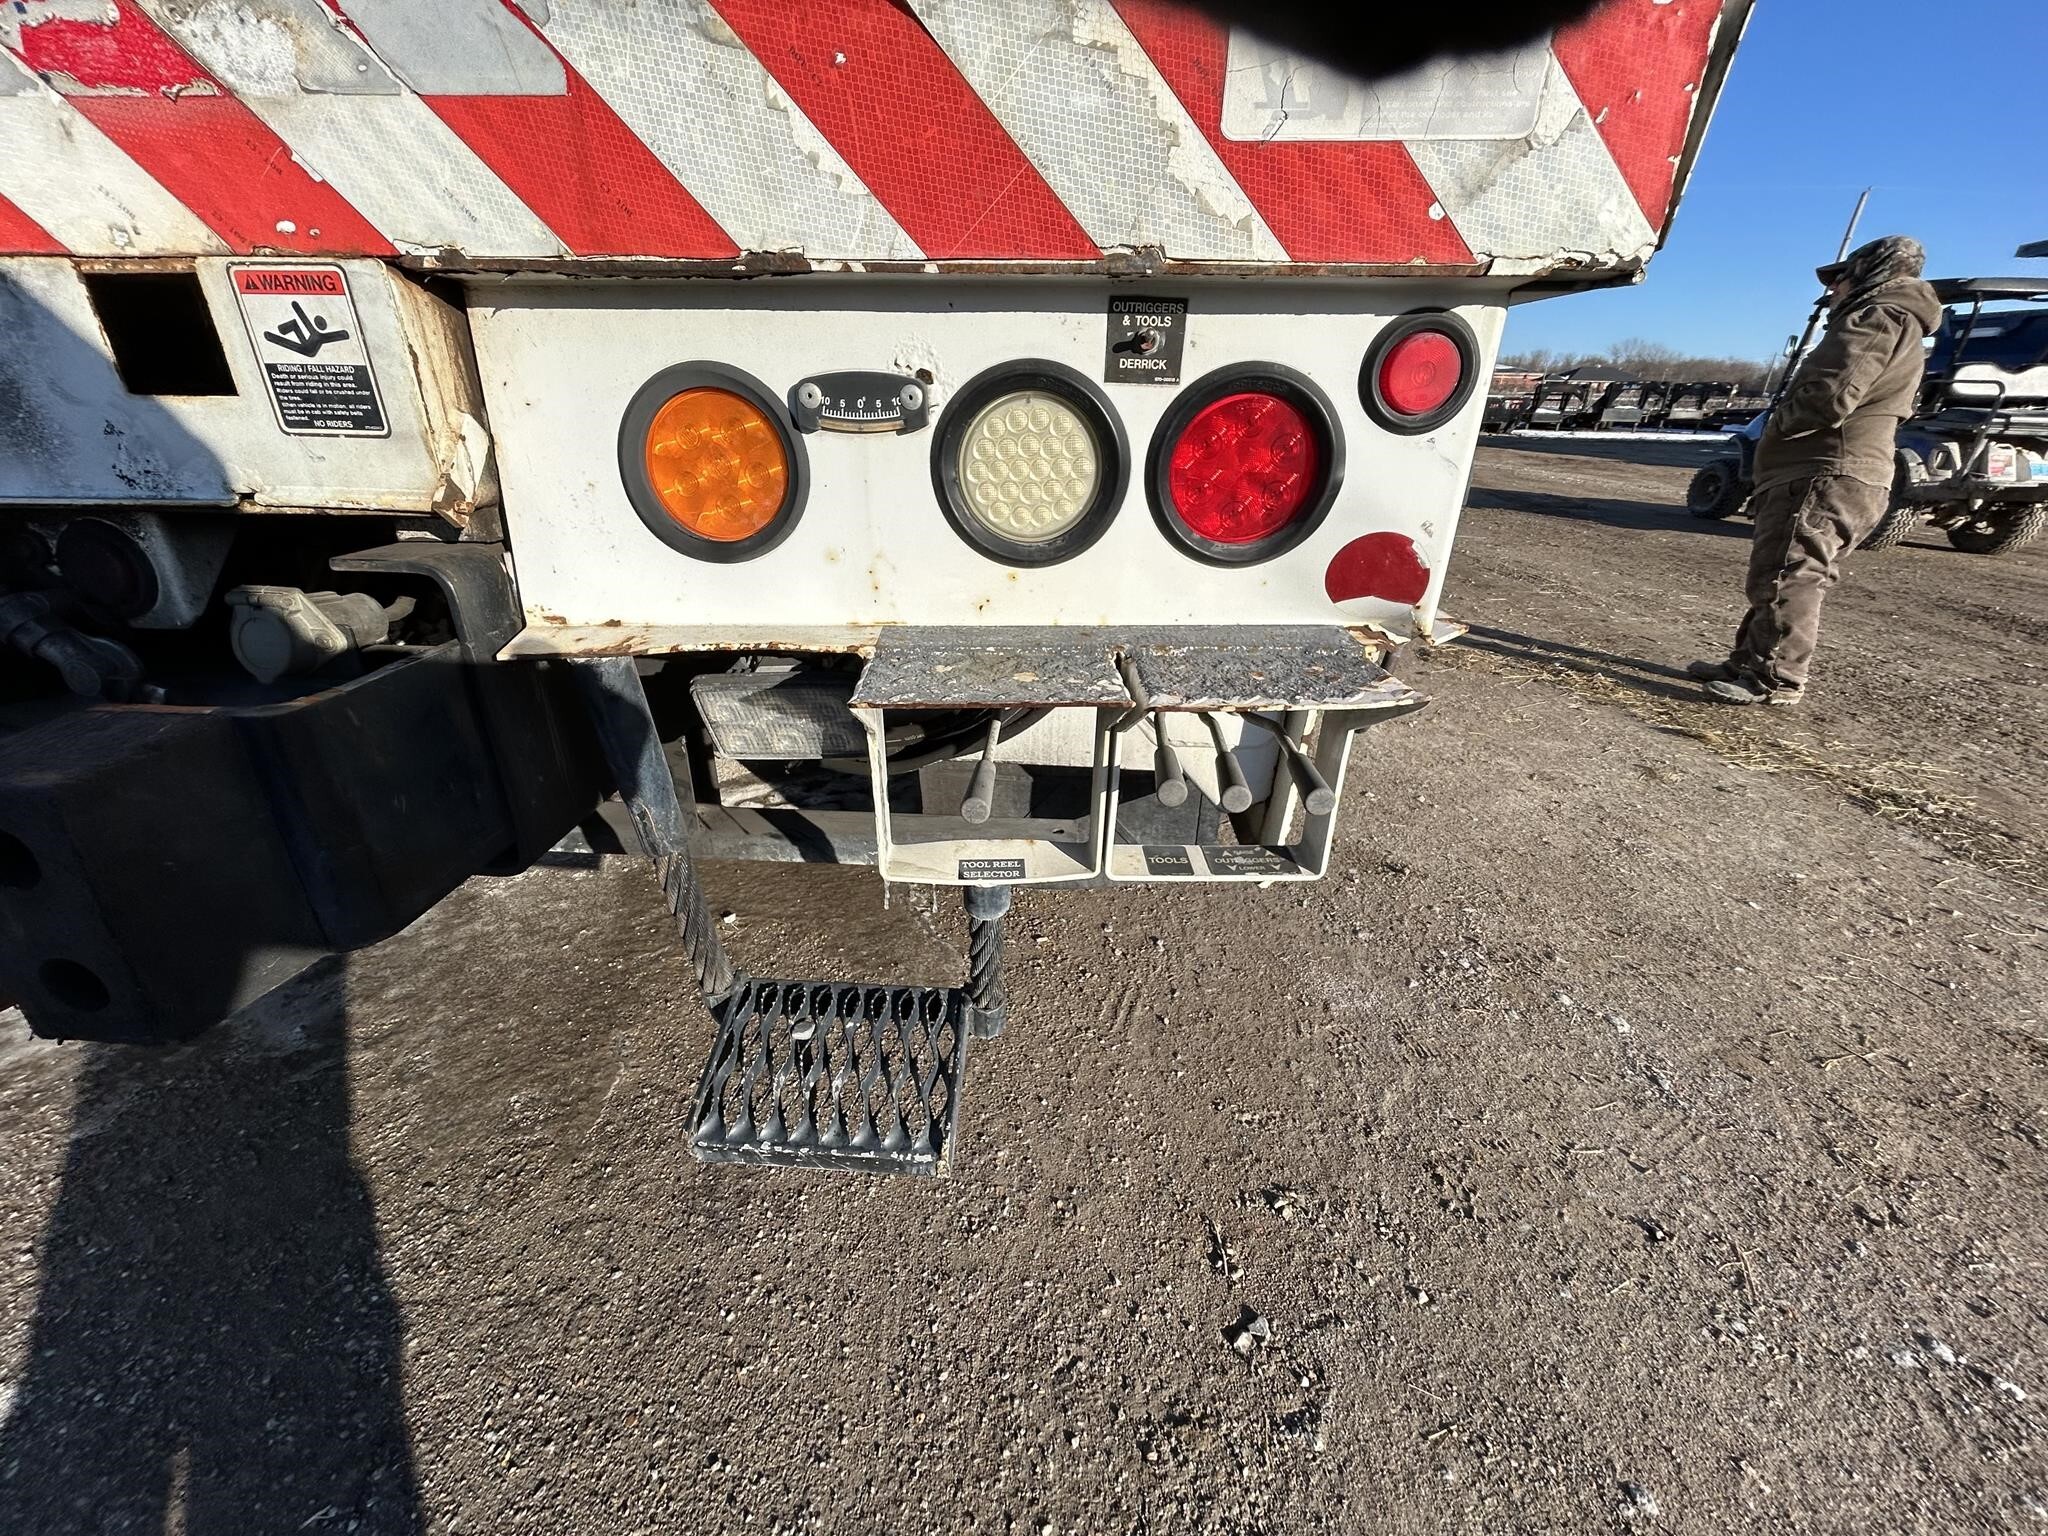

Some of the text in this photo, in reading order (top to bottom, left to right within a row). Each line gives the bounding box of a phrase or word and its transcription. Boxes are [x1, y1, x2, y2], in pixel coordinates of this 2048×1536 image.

[256, 274, 337, 292] WARNING
[1112, 301, 1185, 314] OUTRIGGERS
[1122, 314, 1172, 327] & TOOLS
[277, 364, 303, 372] RIDING
[307, 364, 325, 372] FALL
[325, 365, 354, 373] HAZARD
[1119, 358, 1168, 370] DERRICK
[820, 396, 831, 406] 10
[839, 399, 846, 408] 5
[876, 399, 882, 408] 5
[313, 420, 354, 428] NO RIDERS
[962, 860, 1021, 869] TOOL REEL
[1148, 856, 1189, 864] TOOLS
[963, 870, 1021, 878] SELECTOR
